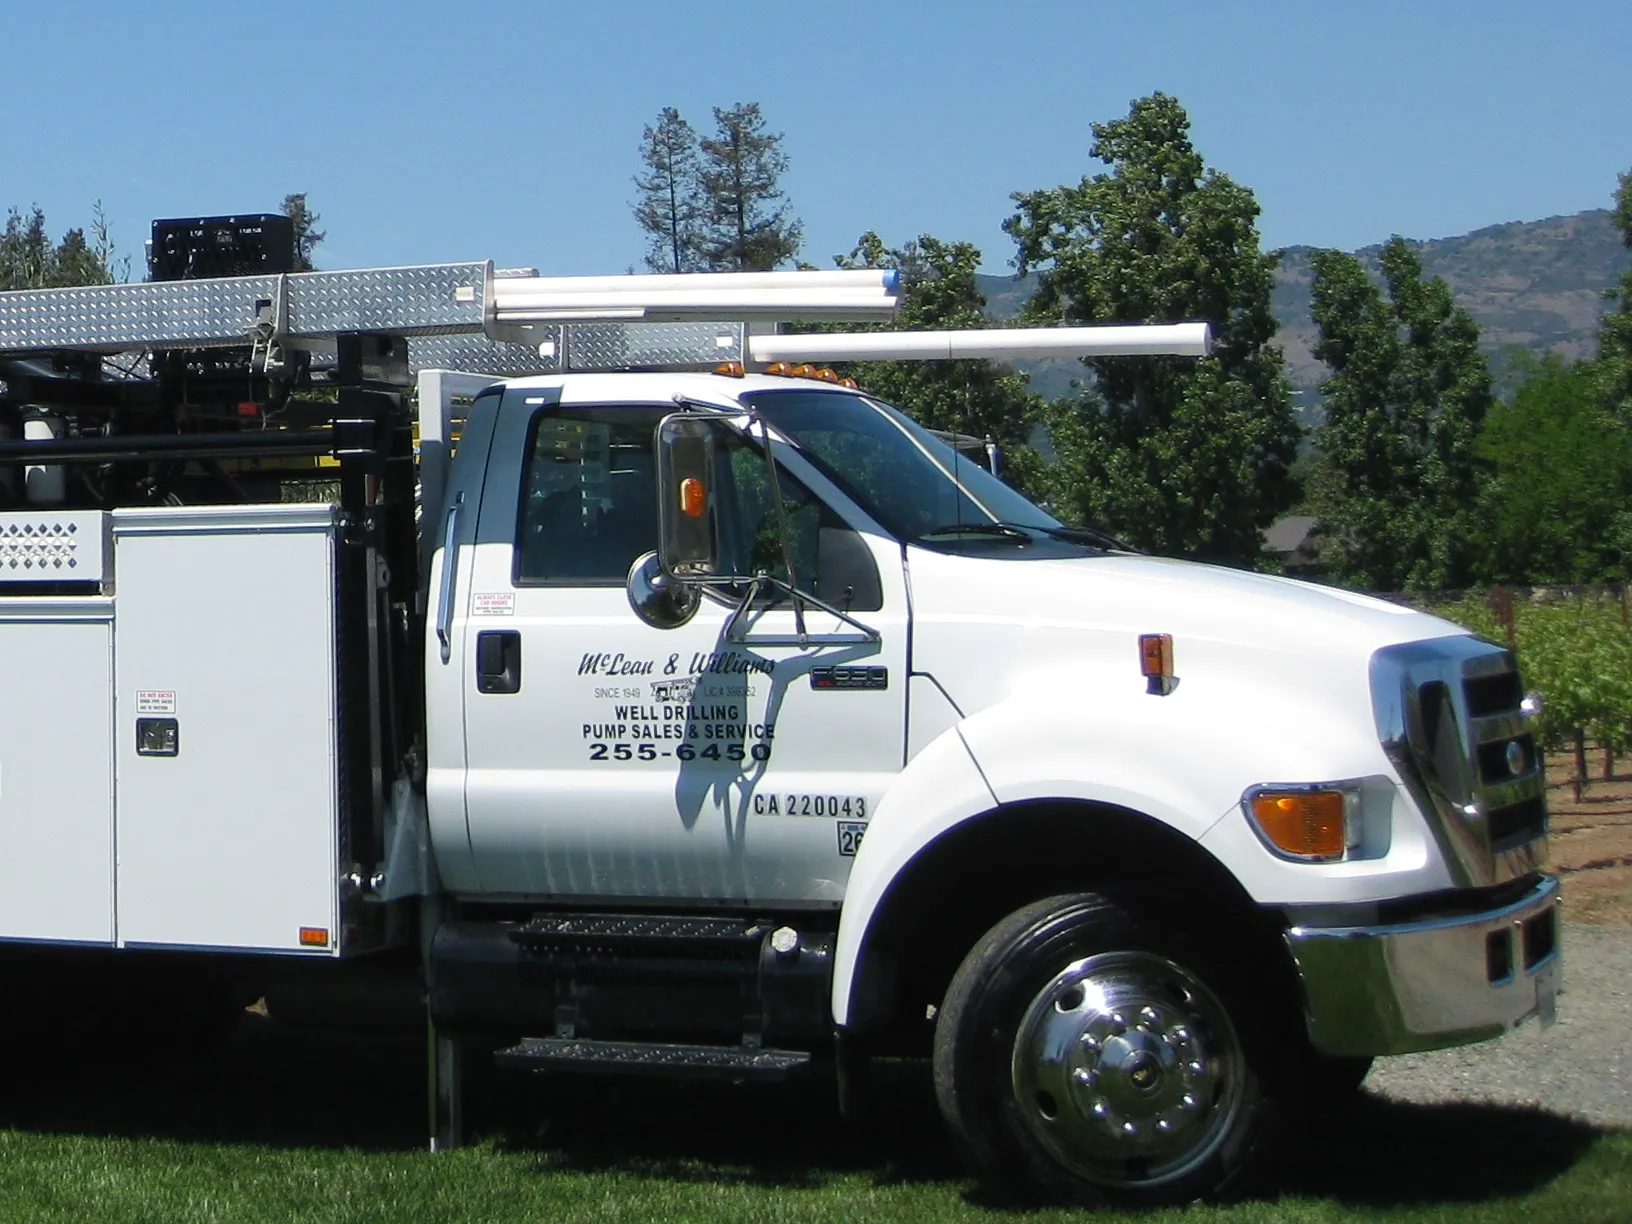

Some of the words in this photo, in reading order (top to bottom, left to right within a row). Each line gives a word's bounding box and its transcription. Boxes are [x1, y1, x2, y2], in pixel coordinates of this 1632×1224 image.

[577, 652, 654, 676] McLean
[663, 652, 680, 676] &
[689, 651, 775, 675] Williams
[594, 687, 620, 699] SINCE
[615, 705, 658, 721] WELL
[663, 705, 739, 721] DRILLING
[583, 724, 627, 739] PUMP
[632, 724, 683, 739] SALES
[689, 725, 699, 739] &
[704, 724, 775, 739] SERVICE
[589, 743, 772, 761] 255-6450
[754, 794, 779, 815] CA
[787, 794, 866, 817] 220043
